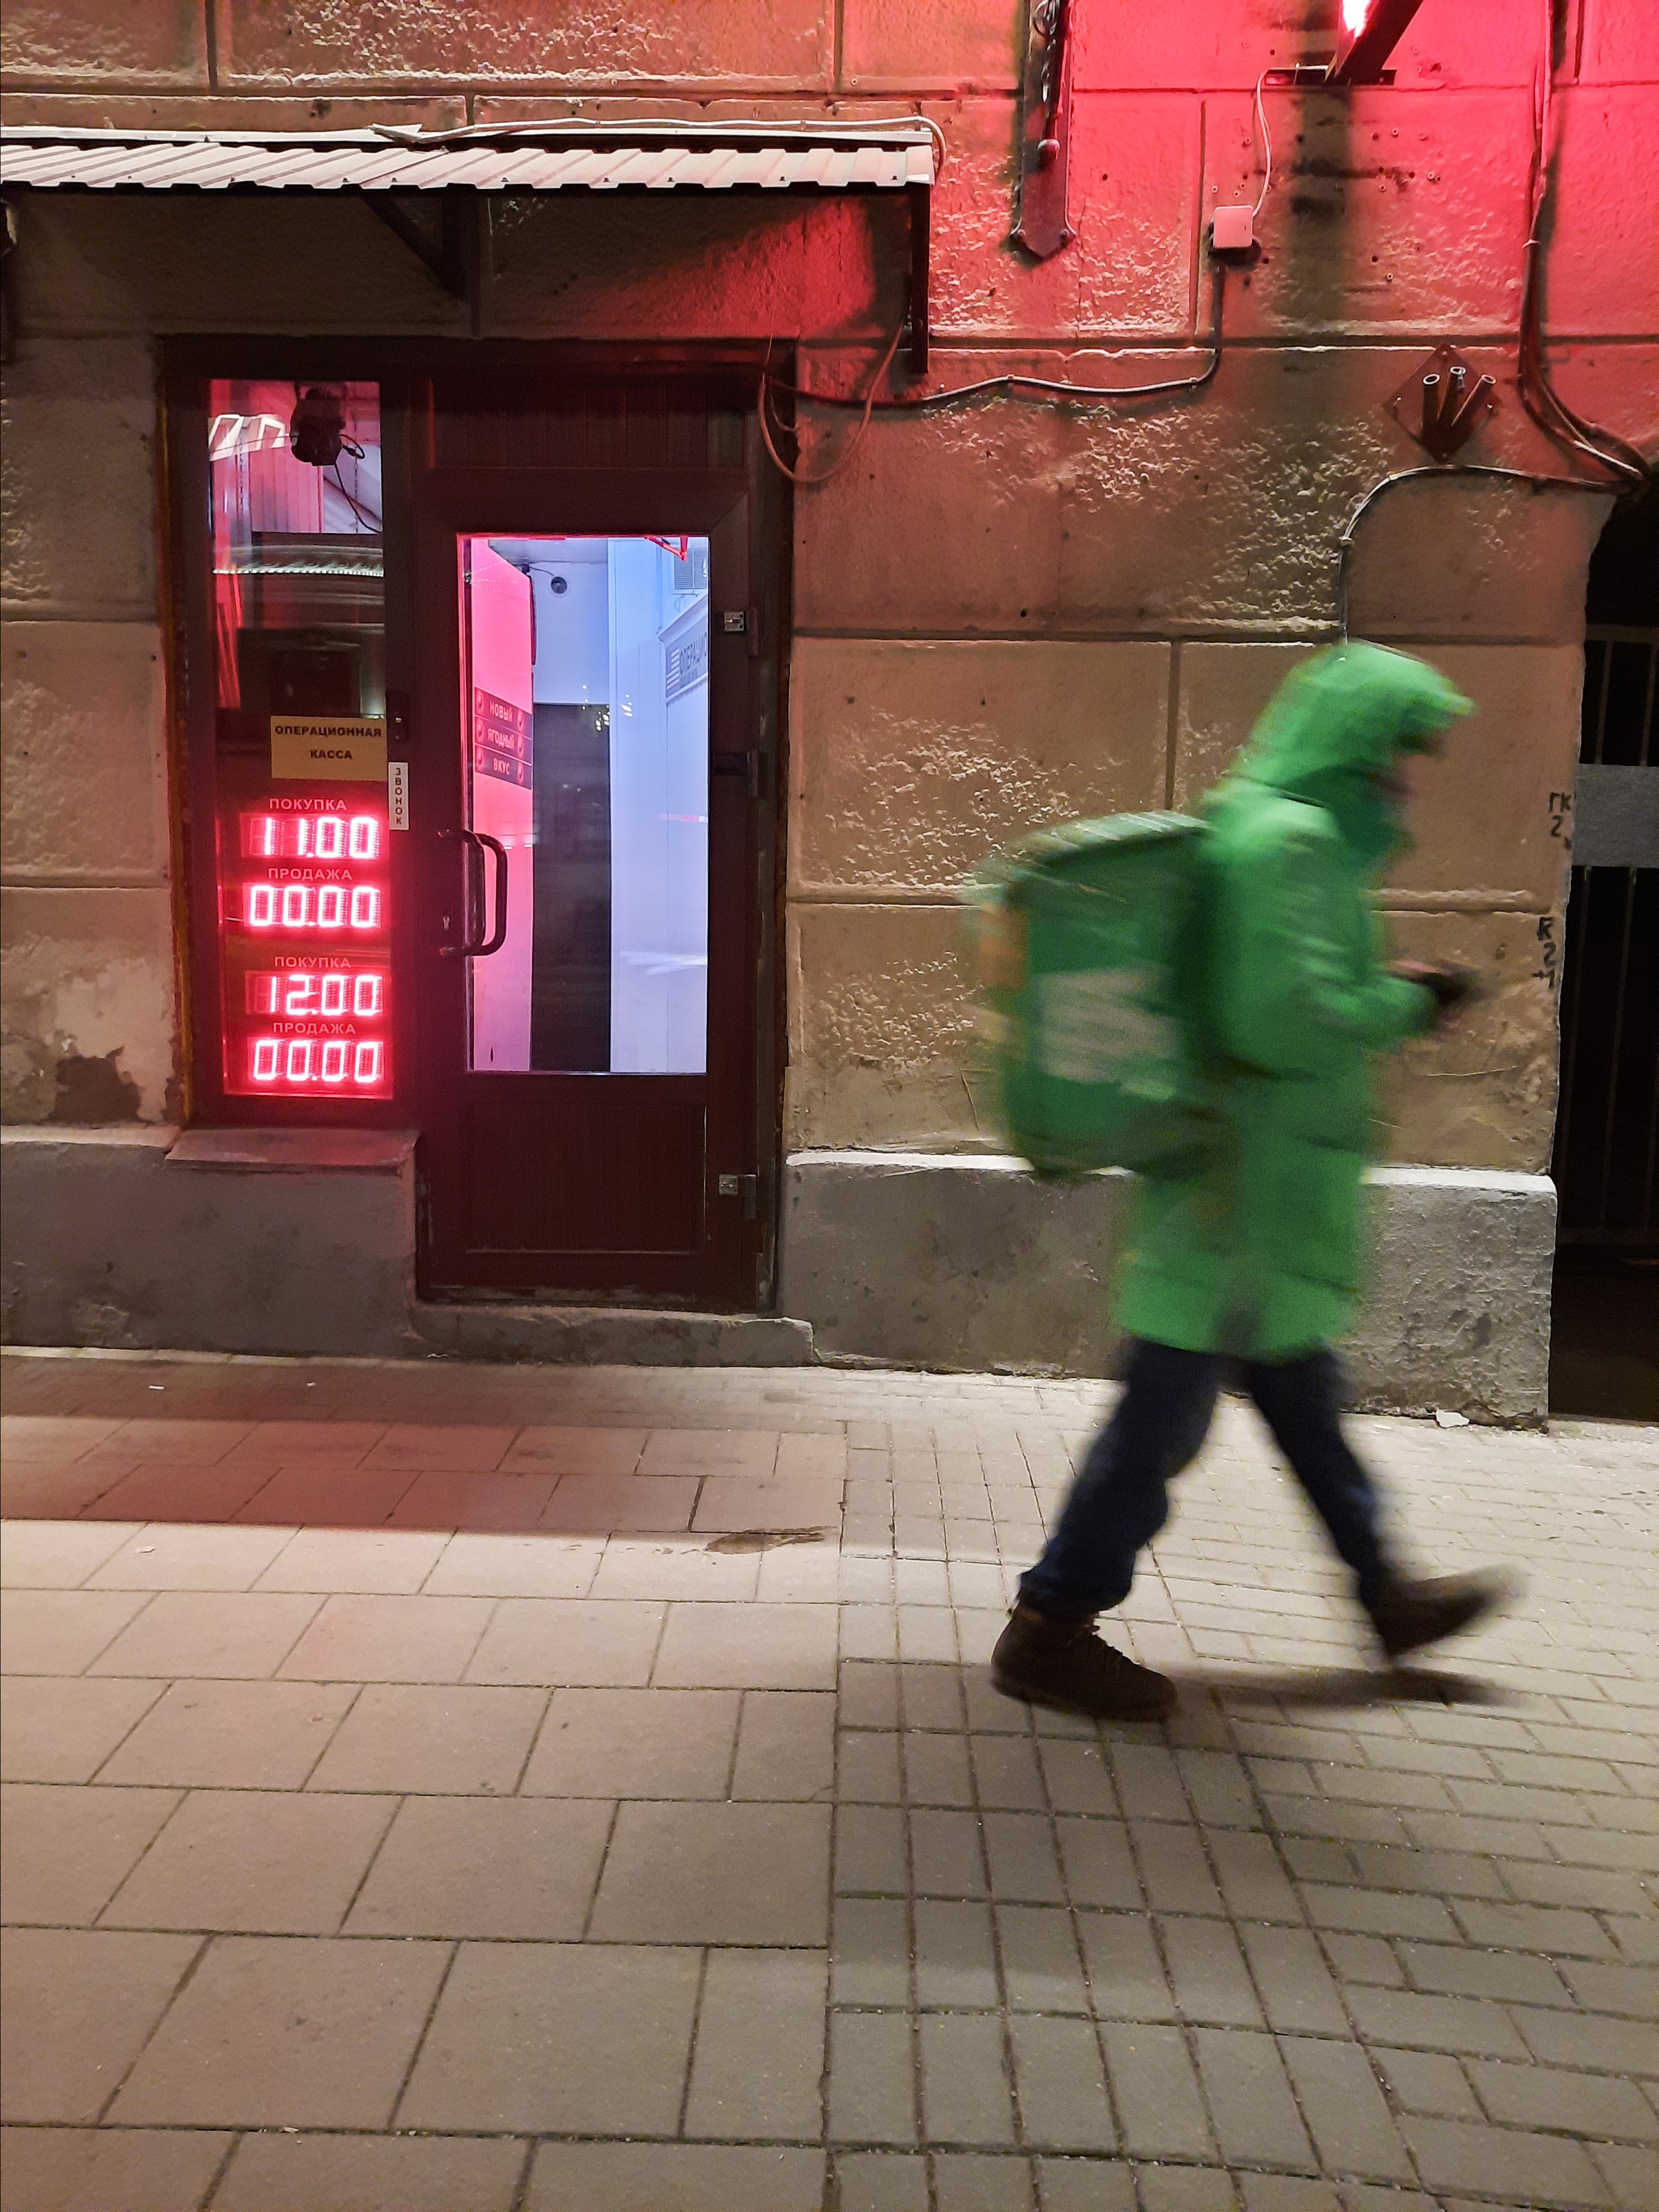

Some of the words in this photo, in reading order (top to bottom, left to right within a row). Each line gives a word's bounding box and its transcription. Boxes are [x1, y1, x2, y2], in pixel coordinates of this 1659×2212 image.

[489, 701, 513, 723] НОВЫЙ
[275, 725, 382, 737] ОПЕРАЦИОННАЯ
[487, 727, 515, 751] ЯГОДНЫЙ
[310, 749, 353, 760] КАССА
[493, 758, 511, 775] ВКУС
[269, 798, 347, 810] ПОКУПКА
[395, 767, 403, 825] ЗВОНОК
[263, 817, 376, 858] 11.00
[268, 868, 353, 881] ПРОДАЖА
[274, 956, 351, 968] ПОКУПКА
[270, 973, 378, 1016] 12.00
[273, 1022, 356, 1035] ПРОДАЖА
[253, 1039, 378, 1083] 00.00
